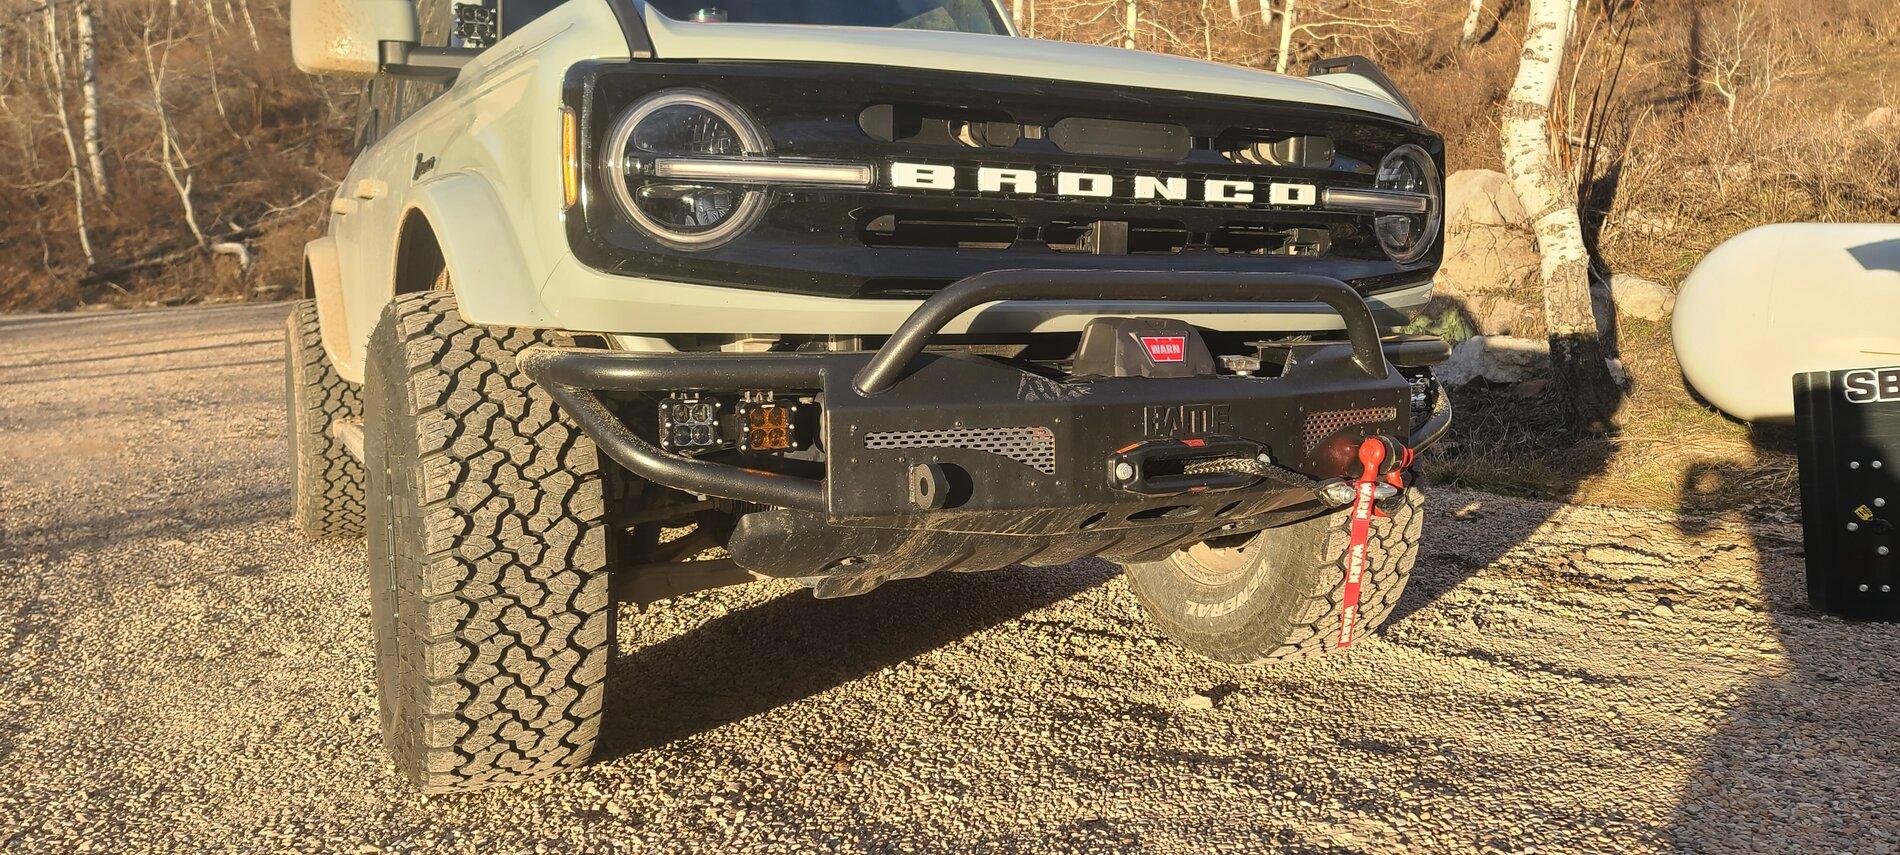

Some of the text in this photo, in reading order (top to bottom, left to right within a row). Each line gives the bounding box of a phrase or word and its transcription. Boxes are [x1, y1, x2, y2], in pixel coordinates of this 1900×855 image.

[890, 161, 1316, 206] BRONCO
[1150, 343, 1181, 355] WARN
[1355, 482, 1373, 519] WARN
[1348, 543, 1365, 583] WARN
[1340, 605, 1355, 643] WARN
